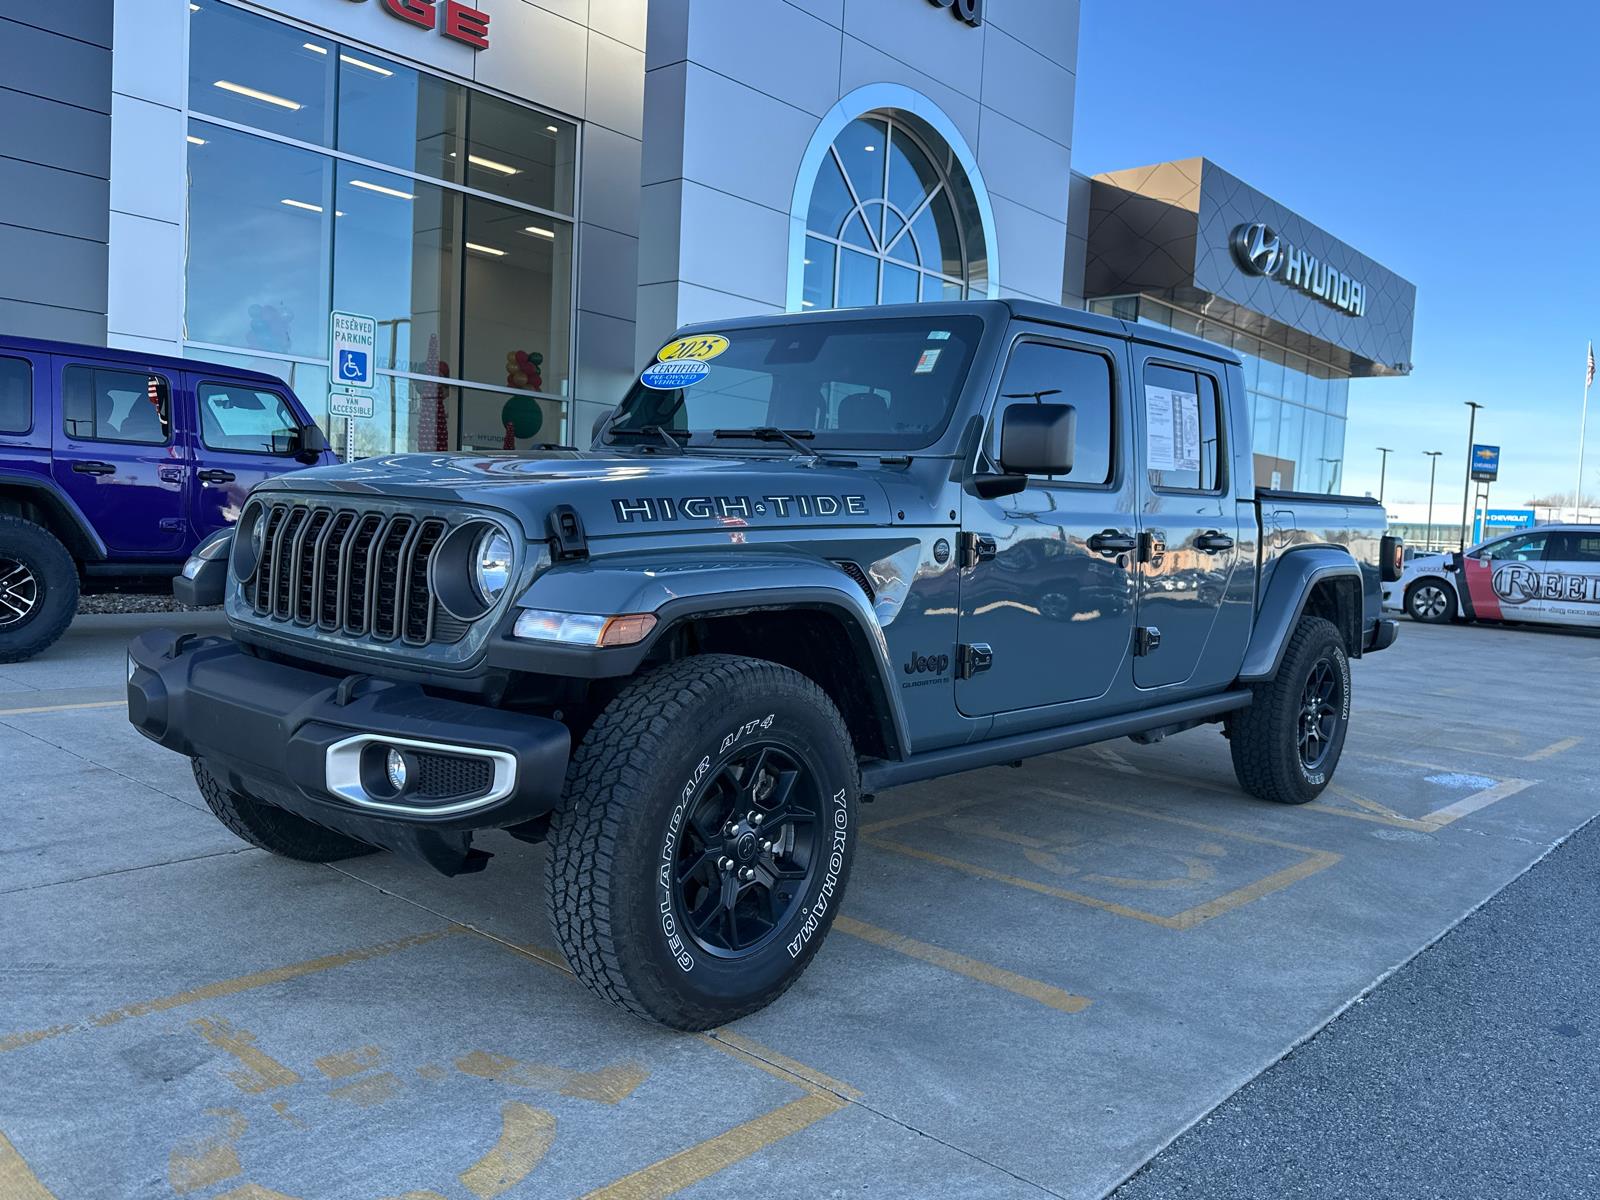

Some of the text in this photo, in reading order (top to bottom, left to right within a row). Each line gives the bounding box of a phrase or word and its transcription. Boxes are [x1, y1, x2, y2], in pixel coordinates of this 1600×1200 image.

[1286, 244, 1367, 317] HYUNDAI
[335, 318, 372, 333] RESERVED
[335, 331, 372, 346] PARKING
[664, 339, 721, 360] 2025
[652, 363, 706, 374] CERTIFIED
[332, 404, 372, 415] ACCESSIBLE
[345, 398, 359, 406] VAN
[611, 494, 869, 523] HIGH TIDE
[1490, 514, 1529, 522] CHEVROLET
[904, 650, 949, 676] Jeep
[902, 678, 943, 689] GLADIATOR
[660, 713, 775, 972] GEOLANDAR A/T4
[787, 788, 848, 959] YOKOHAMA
